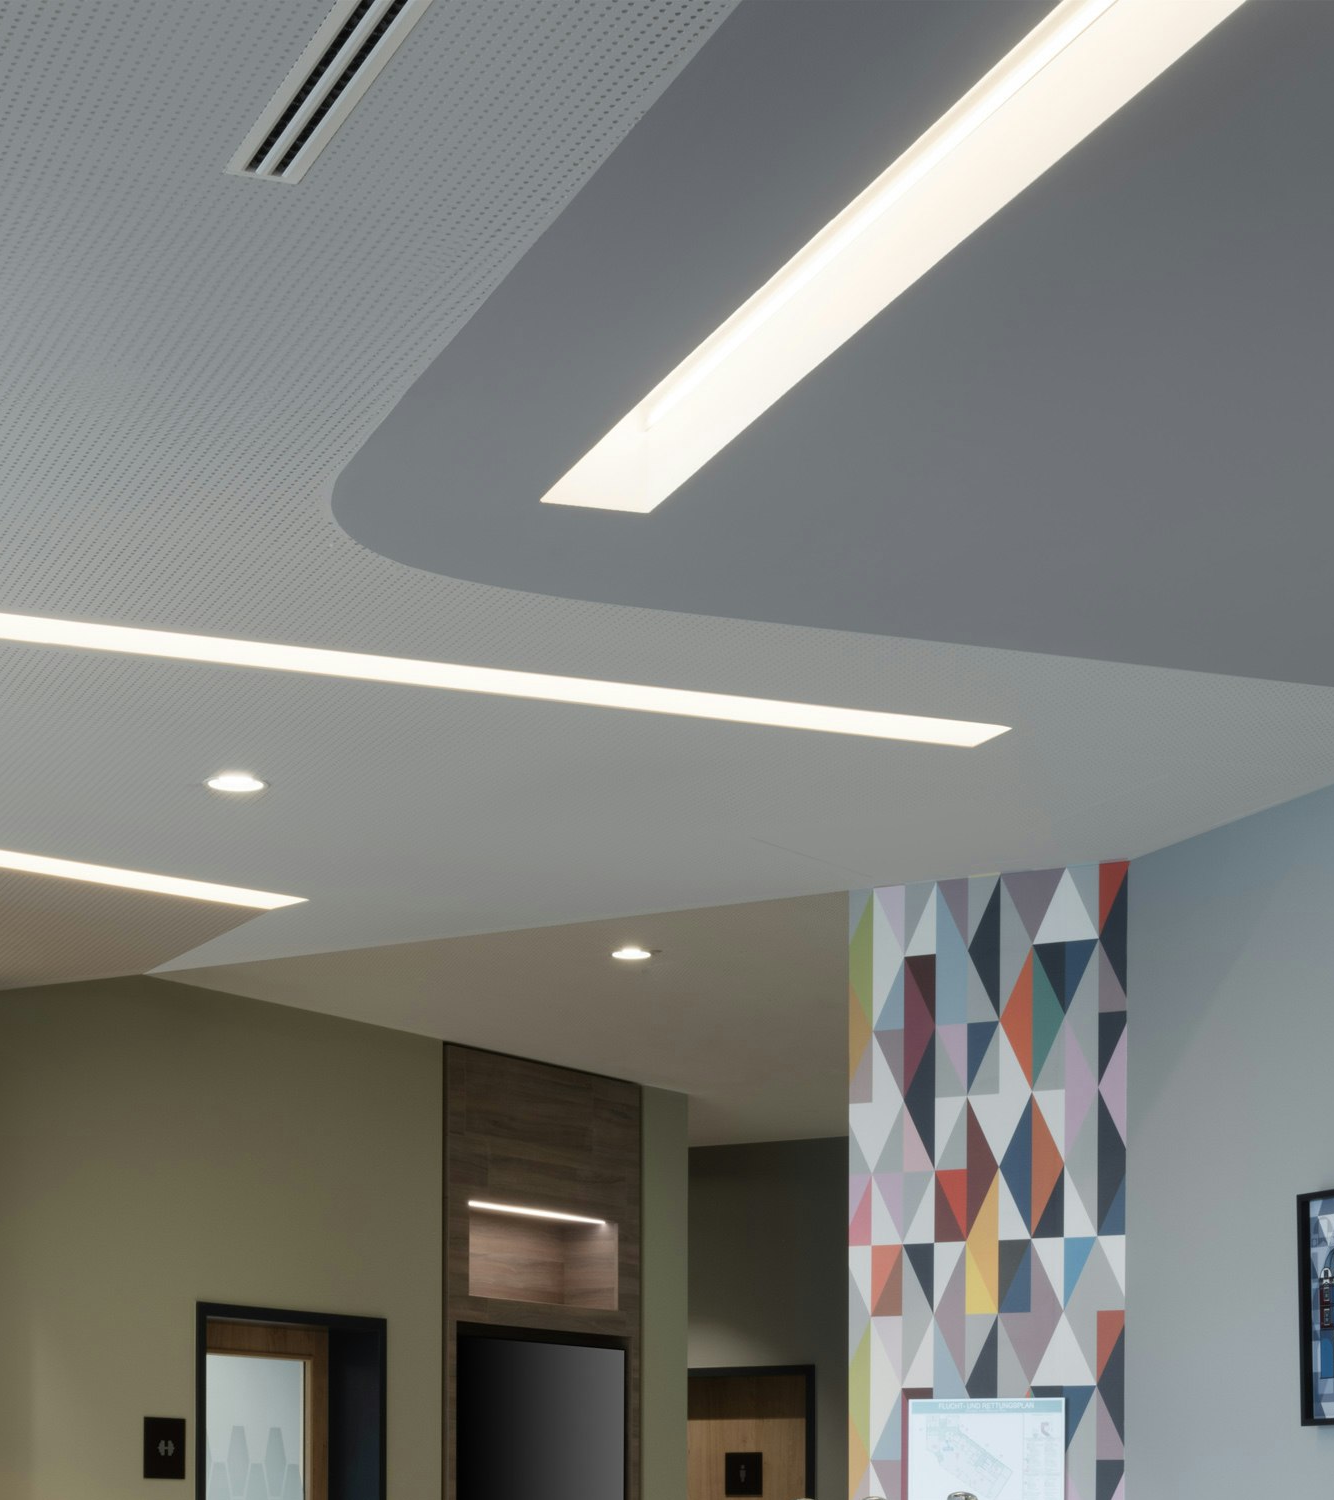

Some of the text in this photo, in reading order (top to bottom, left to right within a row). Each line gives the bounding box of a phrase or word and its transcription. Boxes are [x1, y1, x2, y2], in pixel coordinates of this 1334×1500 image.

[939, 1401, 1035, 1410] FLUCHT- UND RETTUNGSPLAN
